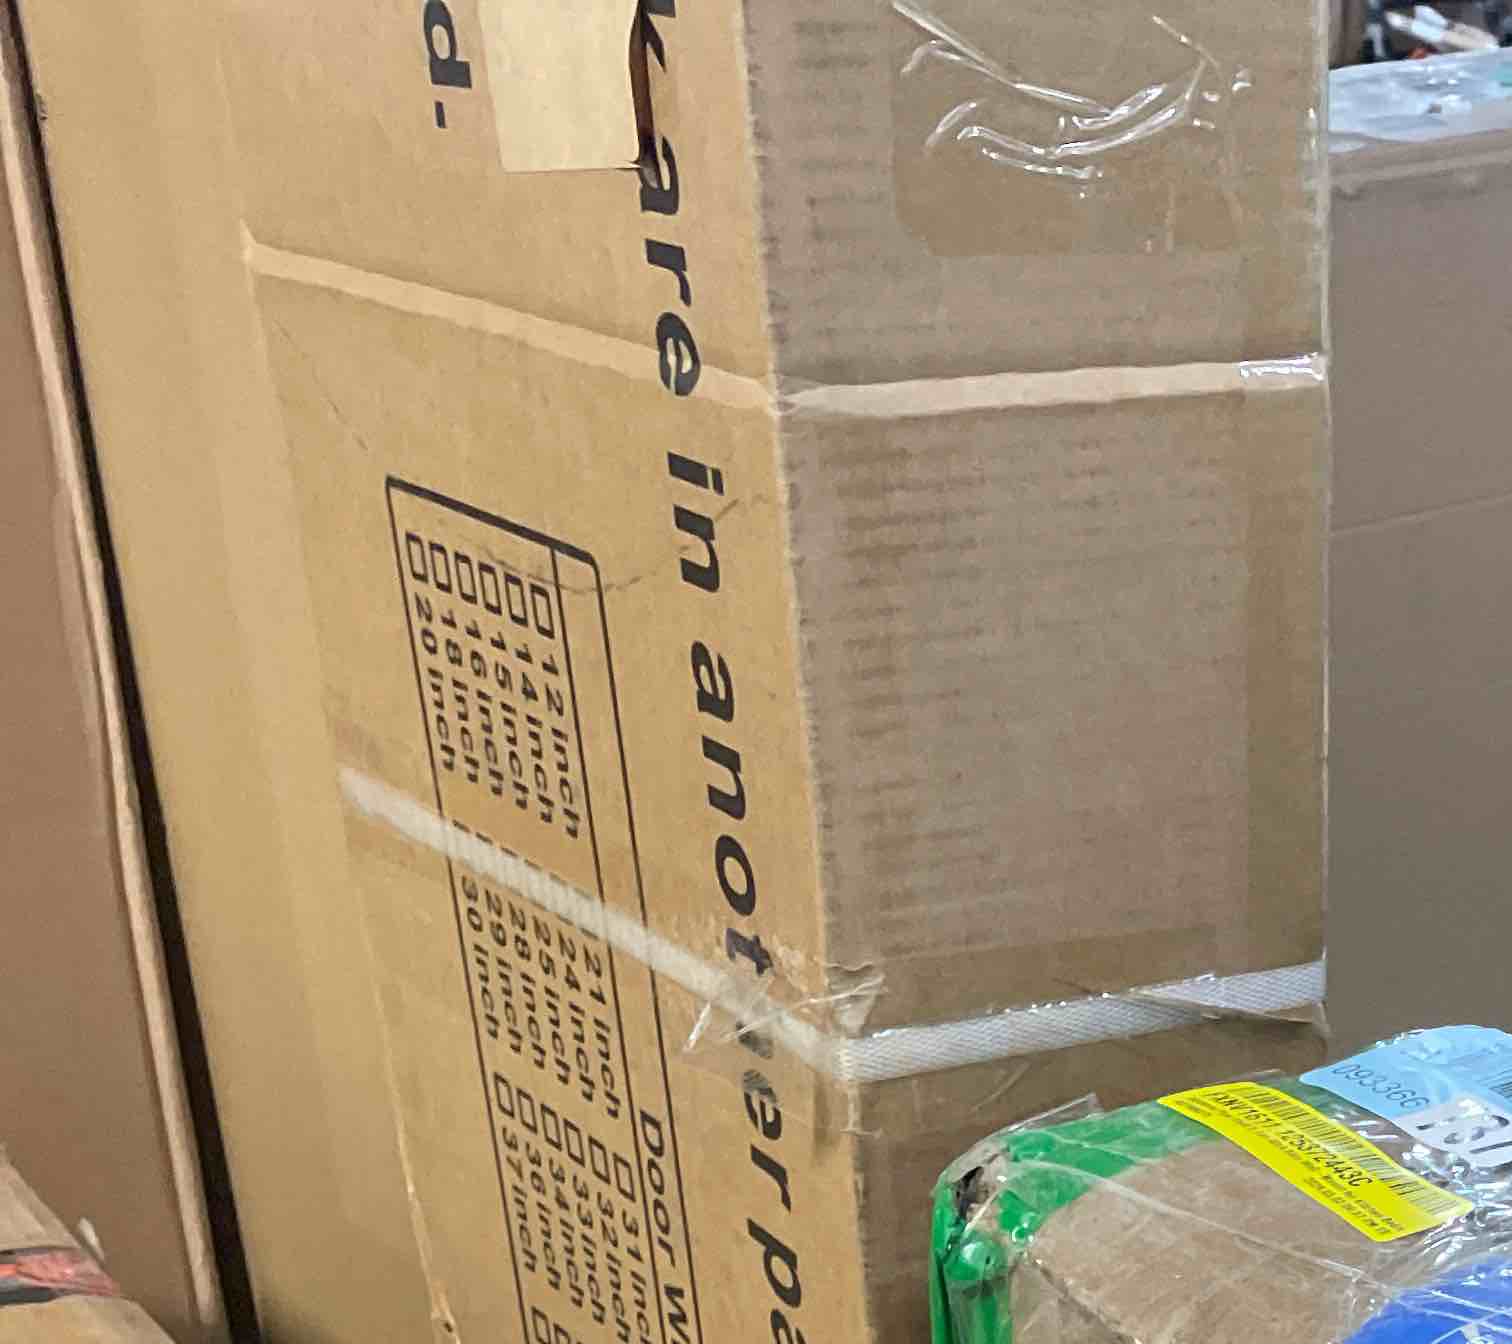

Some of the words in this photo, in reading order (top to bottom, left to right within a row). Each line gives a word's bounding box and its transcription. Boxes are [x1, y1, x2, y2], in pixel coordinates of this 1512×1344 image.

[638, 135, 700, 397] are
[667, 449, 726, 595] in
[414, 591, 440, 658] 20
[439, 604, 464, 669] 18
[463, 615, 488, 680] 16
[488, 626, 513, 693] 15
[513, 638, 539, 704] 14
[538, 649, 565, 719] 12
[460, 874, 484, 936] 30
[484, 887, 508, 950] 29
[508, 901, 532, 964] 28
[532, 914, 556, 980] 25
[557, 930, 581, 993] 24
[582, 943, 606, 1007] 21
[501, 1124, 524, 1182] 37
[547, 1154, 571, 1215] 34
[571, 1171, 594, 1232] 33
[596, 1190, 619, 1251] 32
[638, 1107, 681, 1273] Door
[620, 1206, 643, 1264] 31
